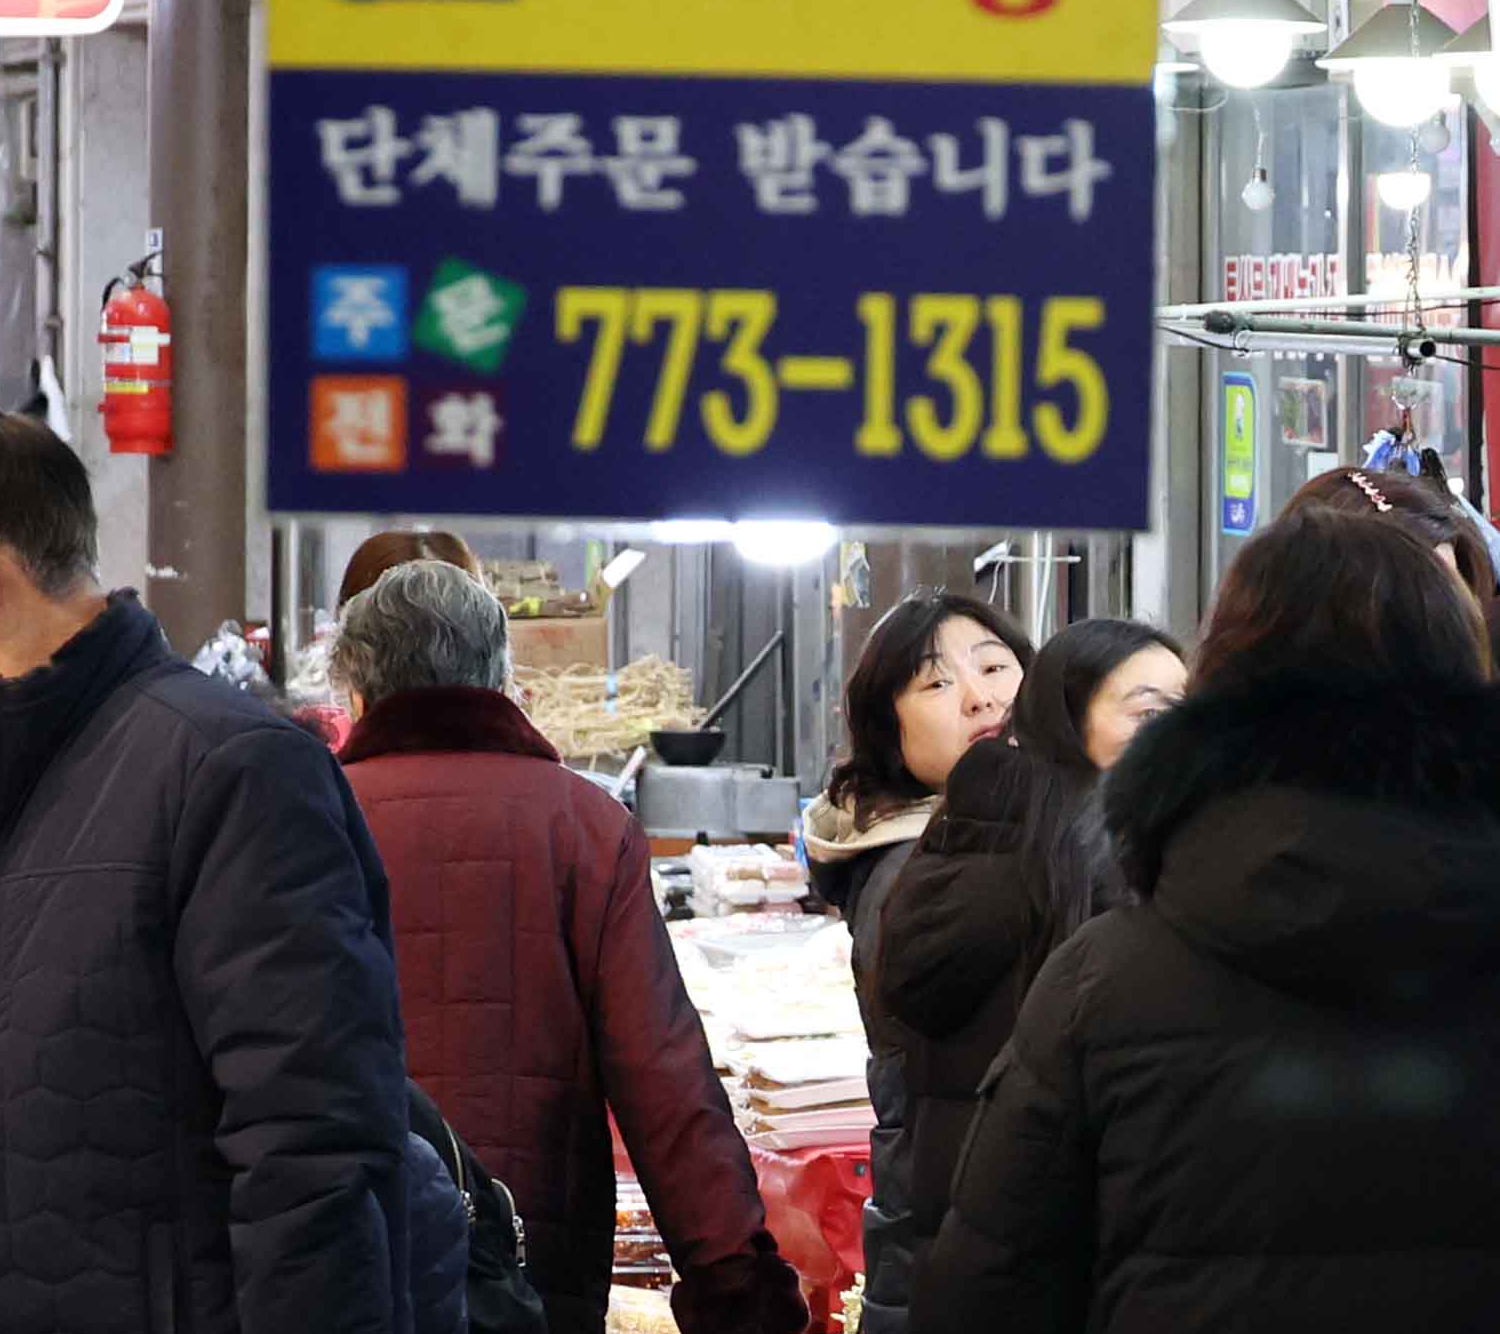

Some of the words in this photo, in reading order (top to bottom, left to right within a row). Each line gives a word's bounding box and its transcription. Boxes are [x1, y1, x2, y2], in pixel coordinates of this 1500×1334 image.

[316, 103, 699, 214] 단체주문
[732, 112, 1113, 222] 받습니다
[554, 285, 1110, 460] 773-1315
